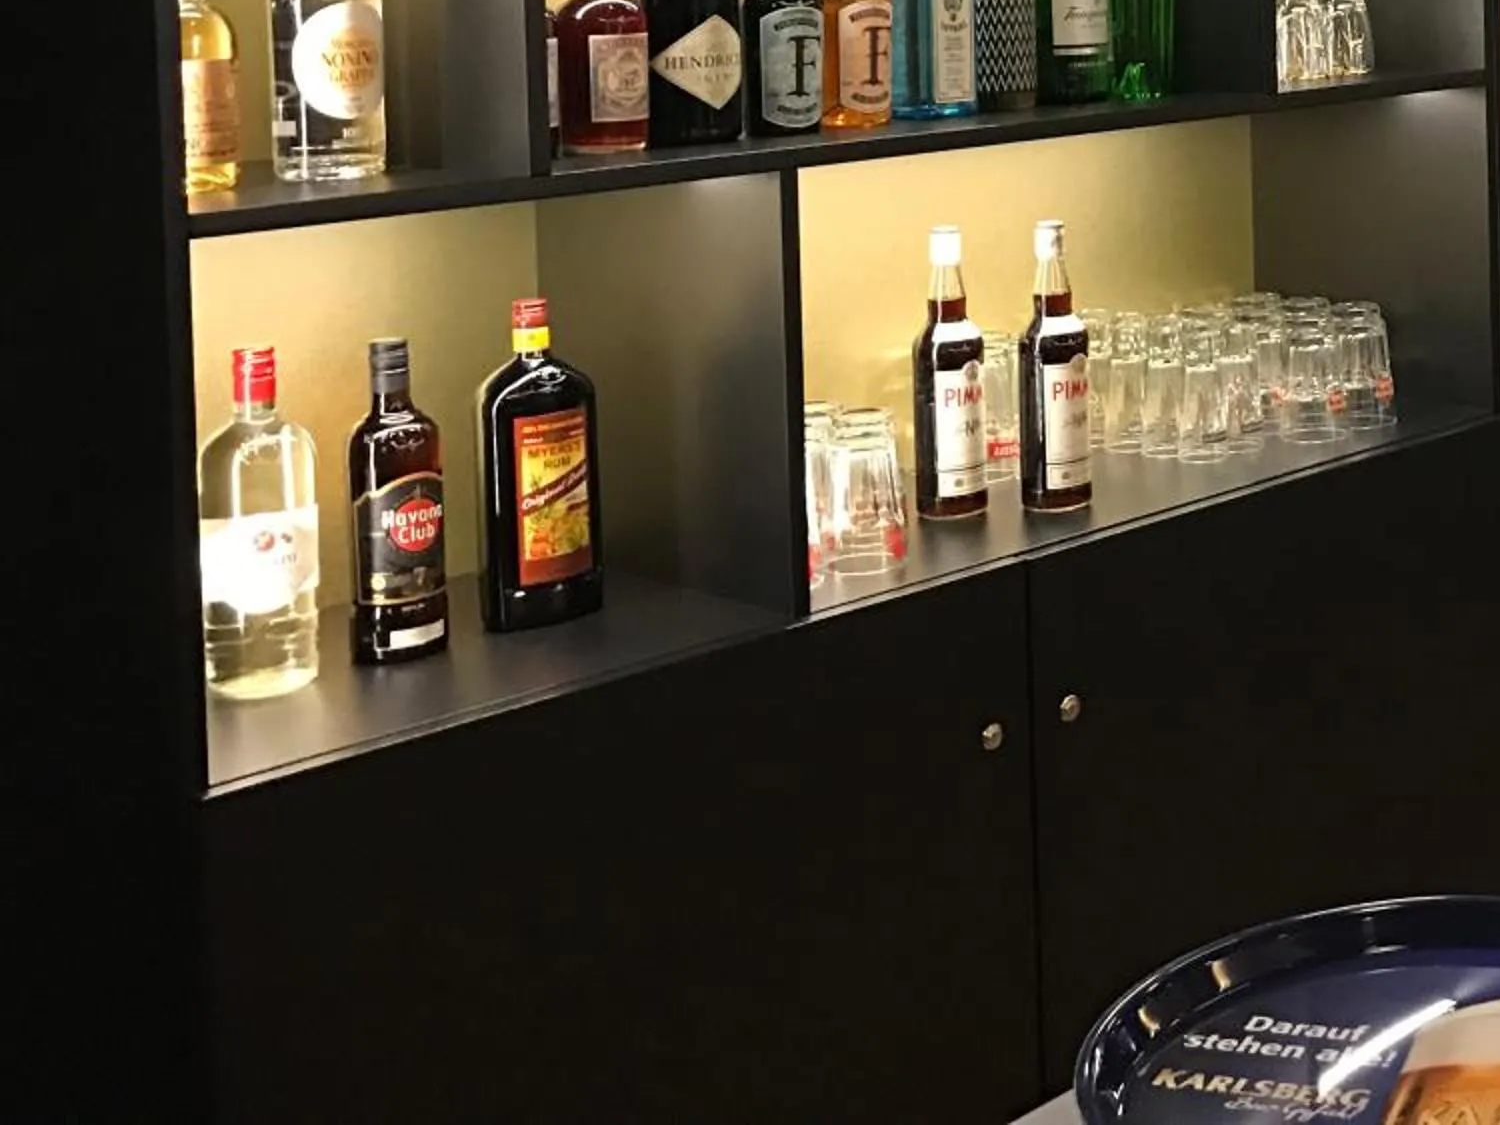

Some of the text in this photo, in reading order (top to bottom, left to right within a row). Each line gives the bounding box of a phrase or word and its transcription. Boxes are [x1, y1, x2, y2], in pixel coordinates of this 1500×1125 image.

[786, 35, 821, 97] F
[381, 504, 443, 530] Havana
[397, 525, 436, 544] Club
[1244, 1014, 1369, 1042] Darauf
[1183, 1033, 1305, 1060] stehen
